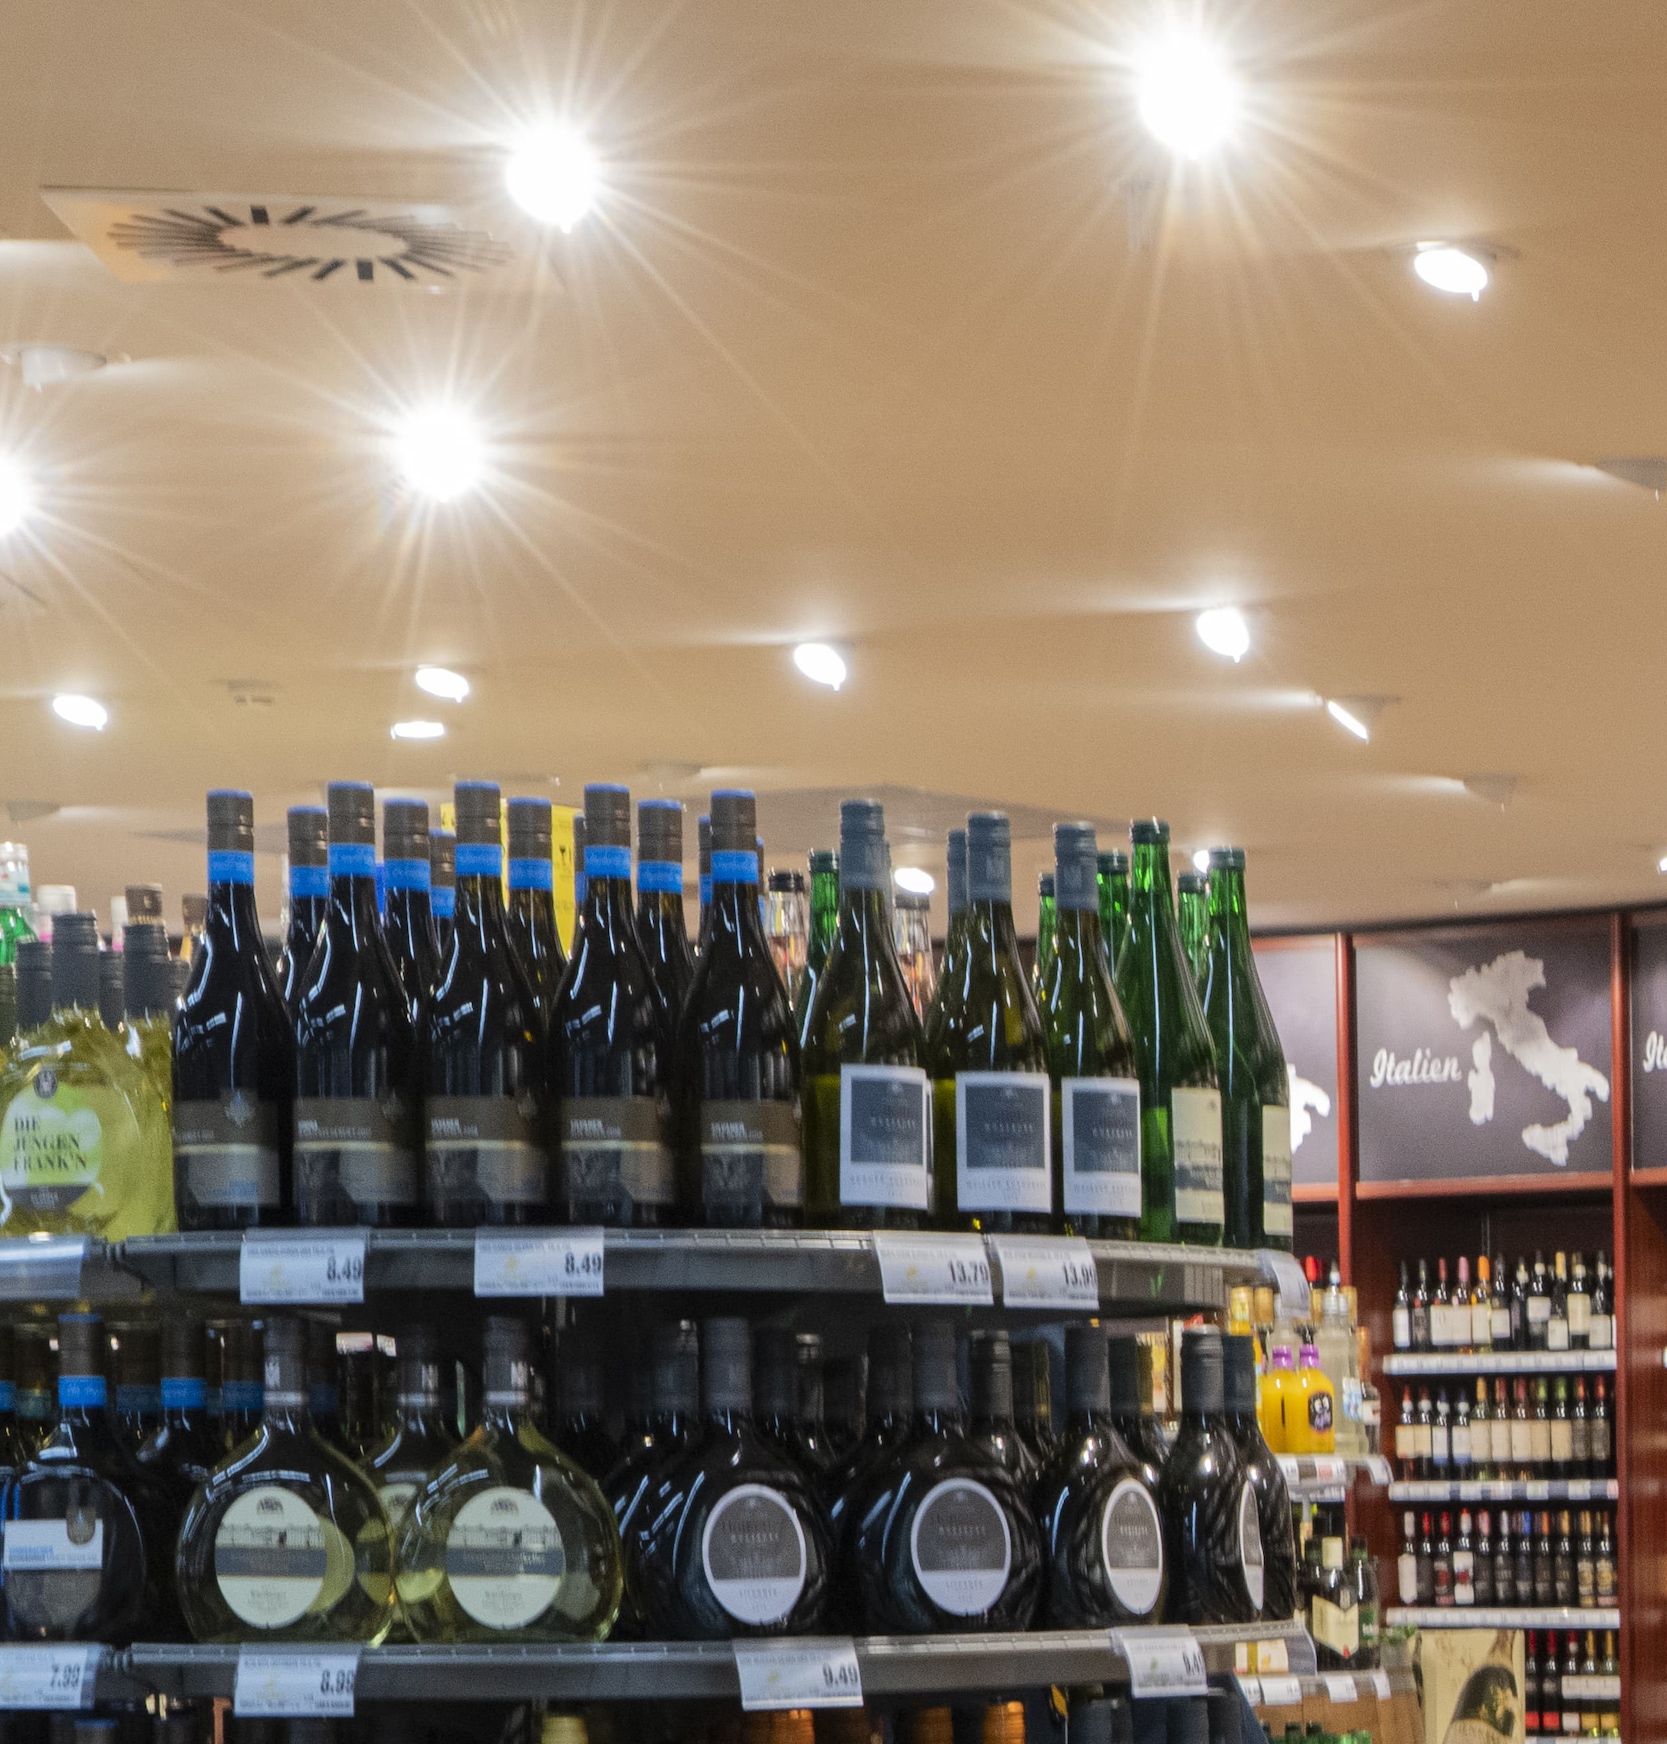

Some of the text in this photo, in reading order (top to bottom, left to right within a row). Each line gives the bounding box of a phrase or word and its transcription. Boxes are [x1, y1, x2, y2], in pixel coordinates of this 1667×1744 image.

[1369, 1046, 1462, 1089] Italien
[13, 1118, 41, 1133] DIE
[326, 1258, 364, 1282] 8.49
[563, 1253, 604, 1277] 8.49
[822, 1662, 860, 1688] 9.49
